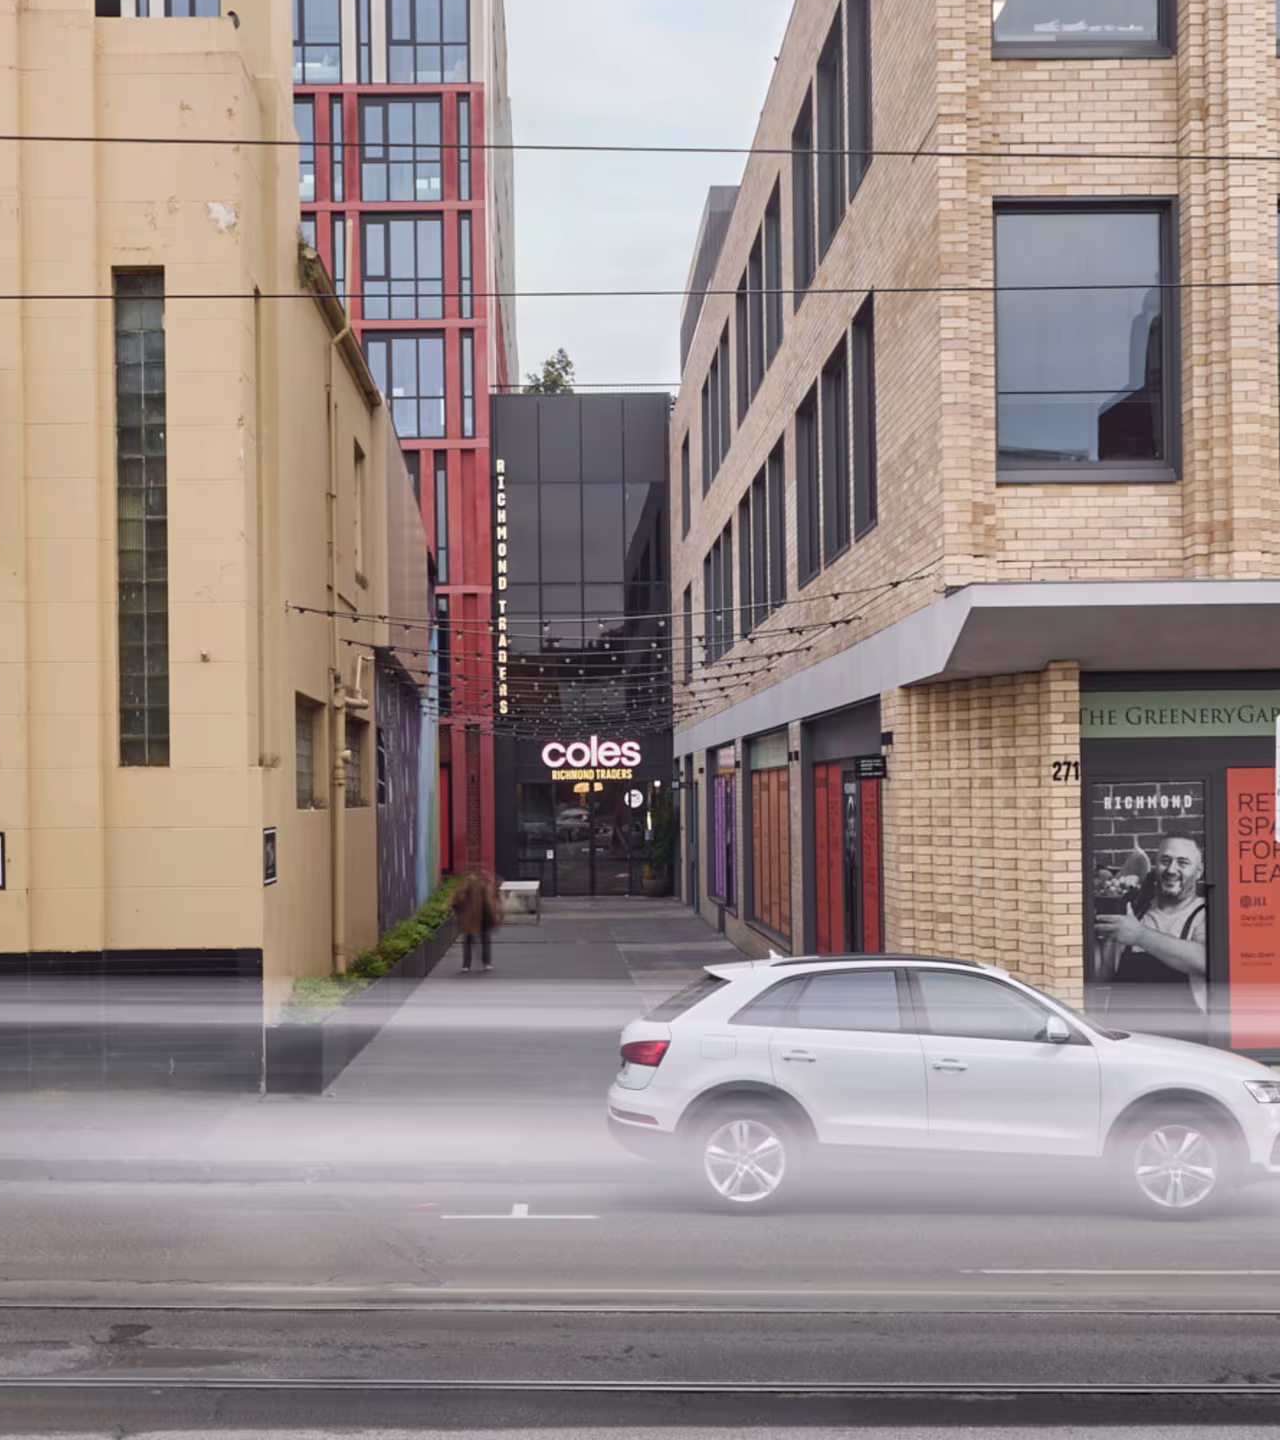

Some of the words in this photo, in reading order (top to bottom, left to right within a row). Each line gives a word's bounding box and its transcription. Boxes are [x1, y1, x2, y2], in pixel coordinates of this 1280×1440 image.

[496, 459, 507, 590] RICHMOND
[498, 600, 508, 714] TRADERS
[542, 735, 641, 768] coles
[552, 769, 595, 780] RICHMOND
[596, 768, 632, 779] TRADERS
[1052, 761, 1080, 781] 271
[1104, 795, 1192, 810] RICHMOND
